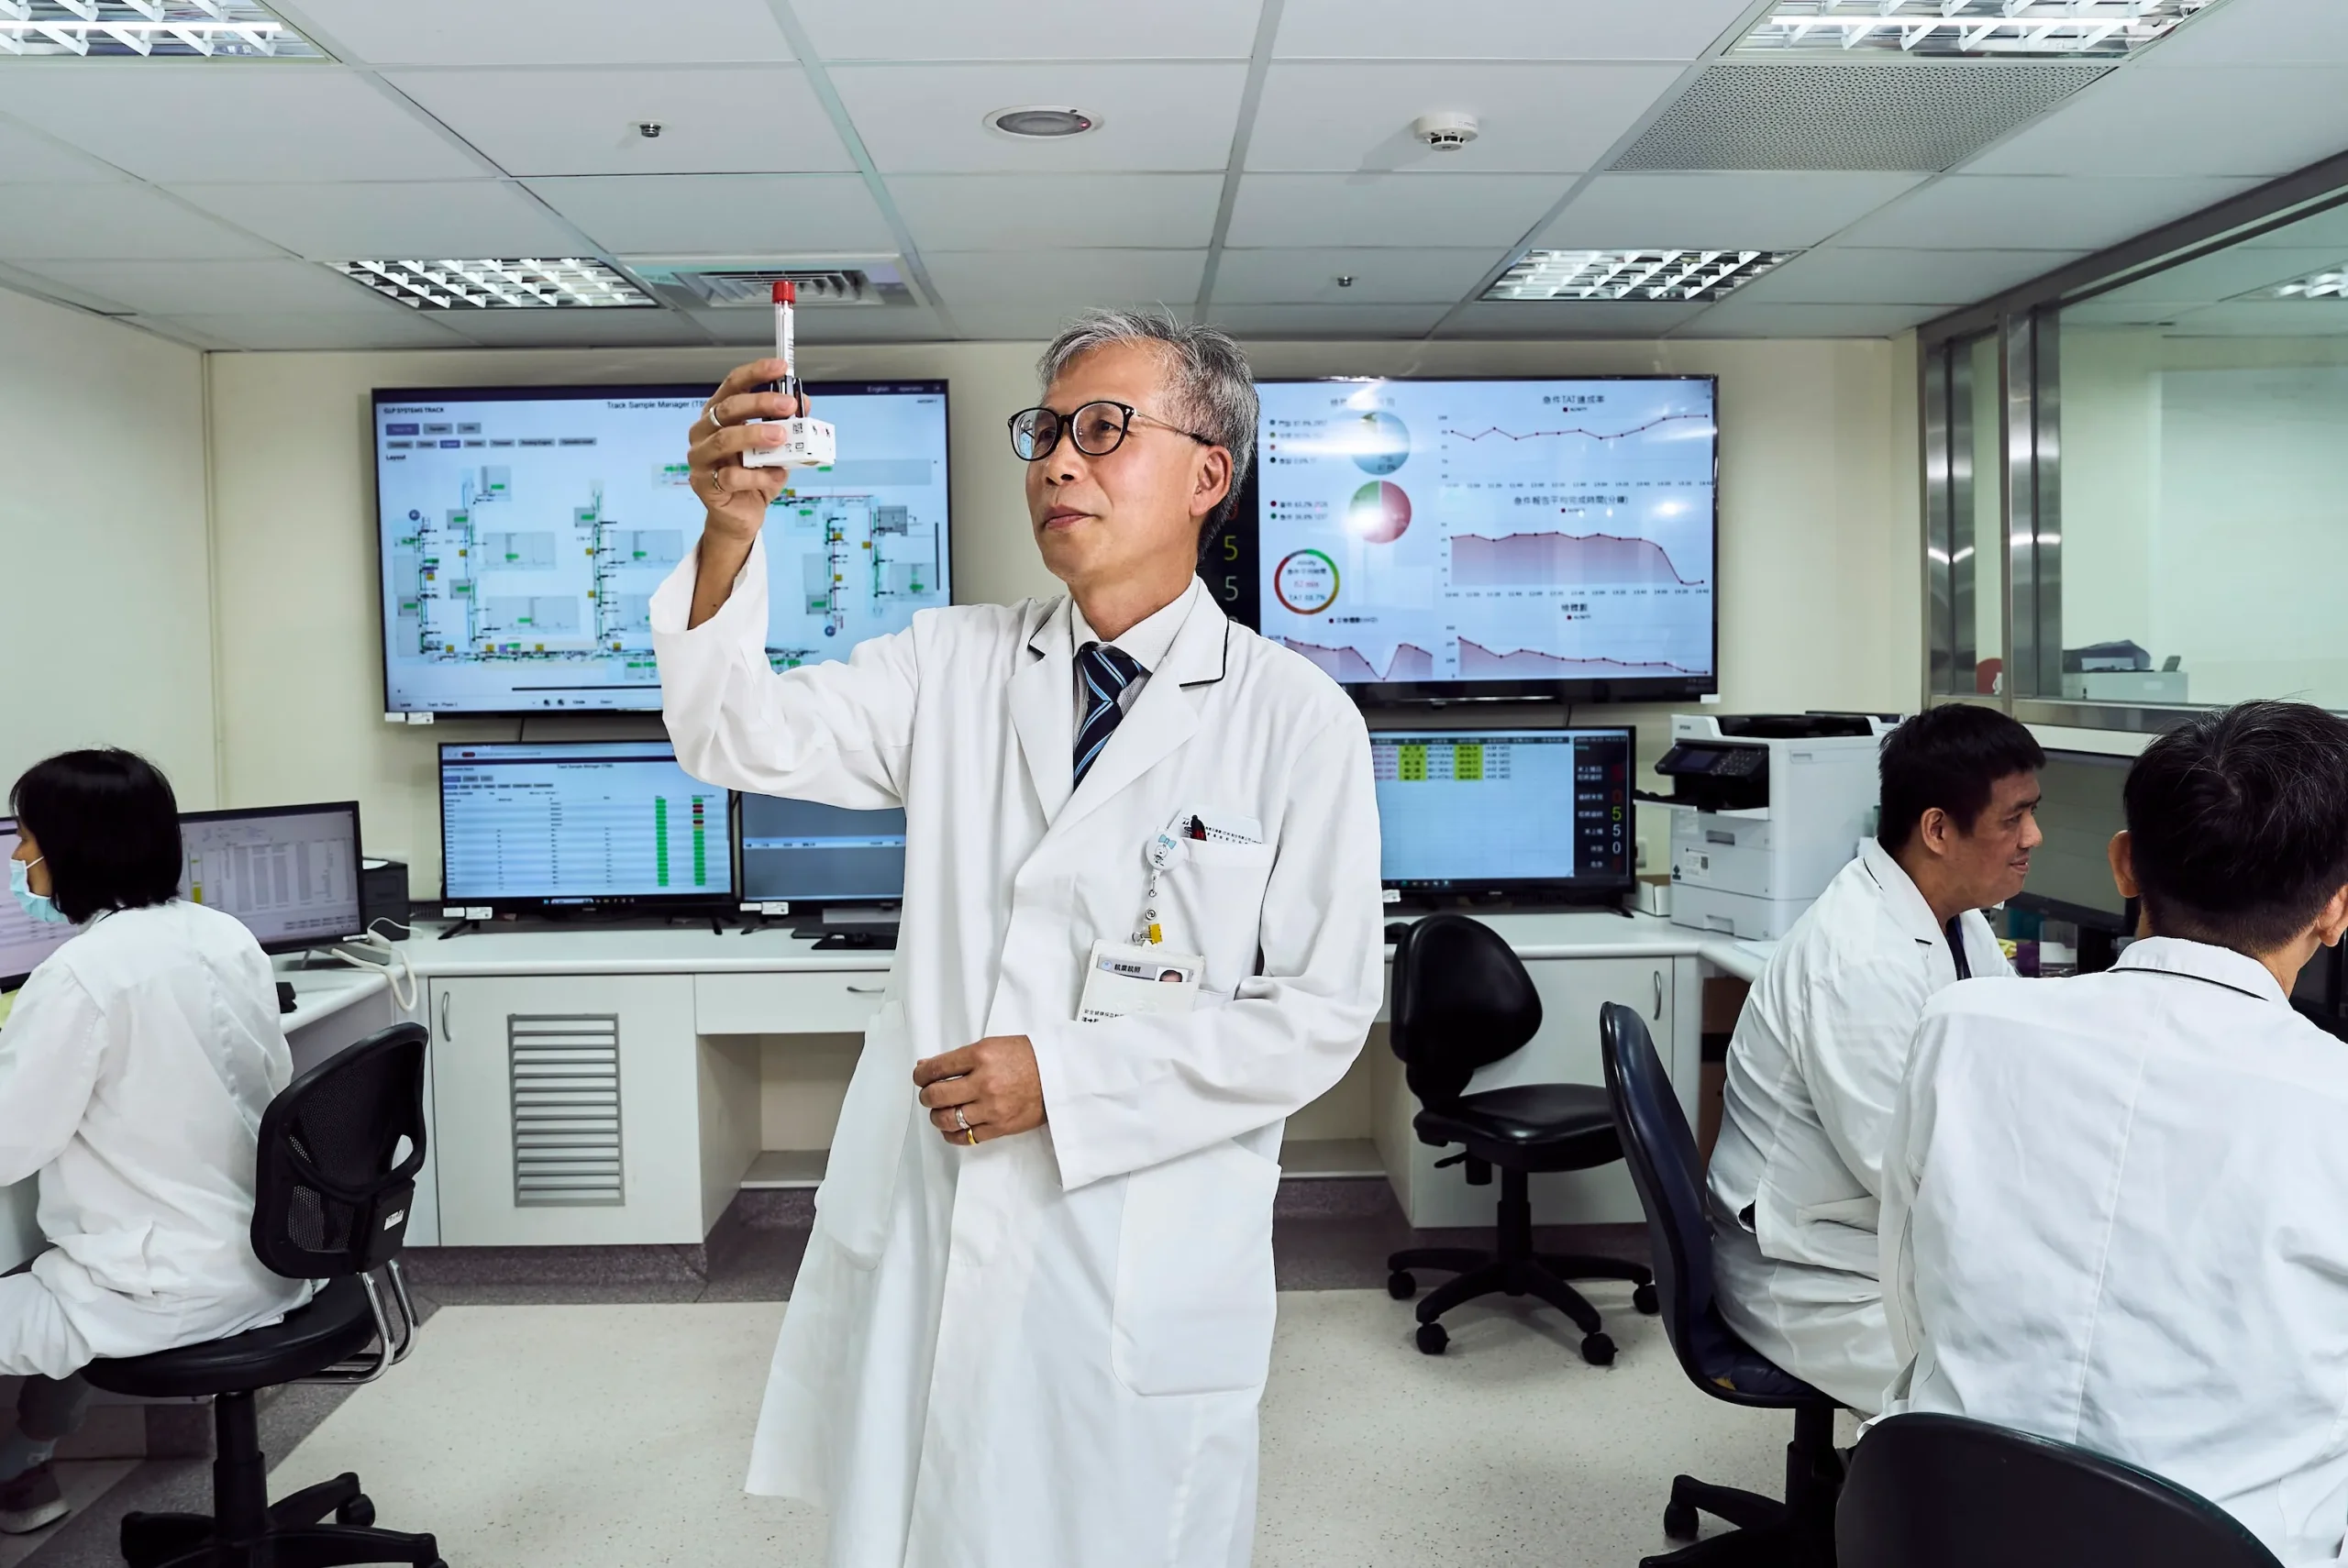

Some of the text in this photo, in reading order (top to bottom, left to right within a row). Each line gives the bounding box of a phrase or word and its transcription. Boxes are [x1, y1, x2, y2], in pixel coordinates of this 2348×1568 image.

[658, 401, 689, 409] Manager
[1224, 536, 1238, 561] 5
[1224, 576, 1239, 602] 5
[1611, 806, 1623, 821] 5
[1612, 823, 1622, 837] 5
[1611, 841, 1622, 855] 0
